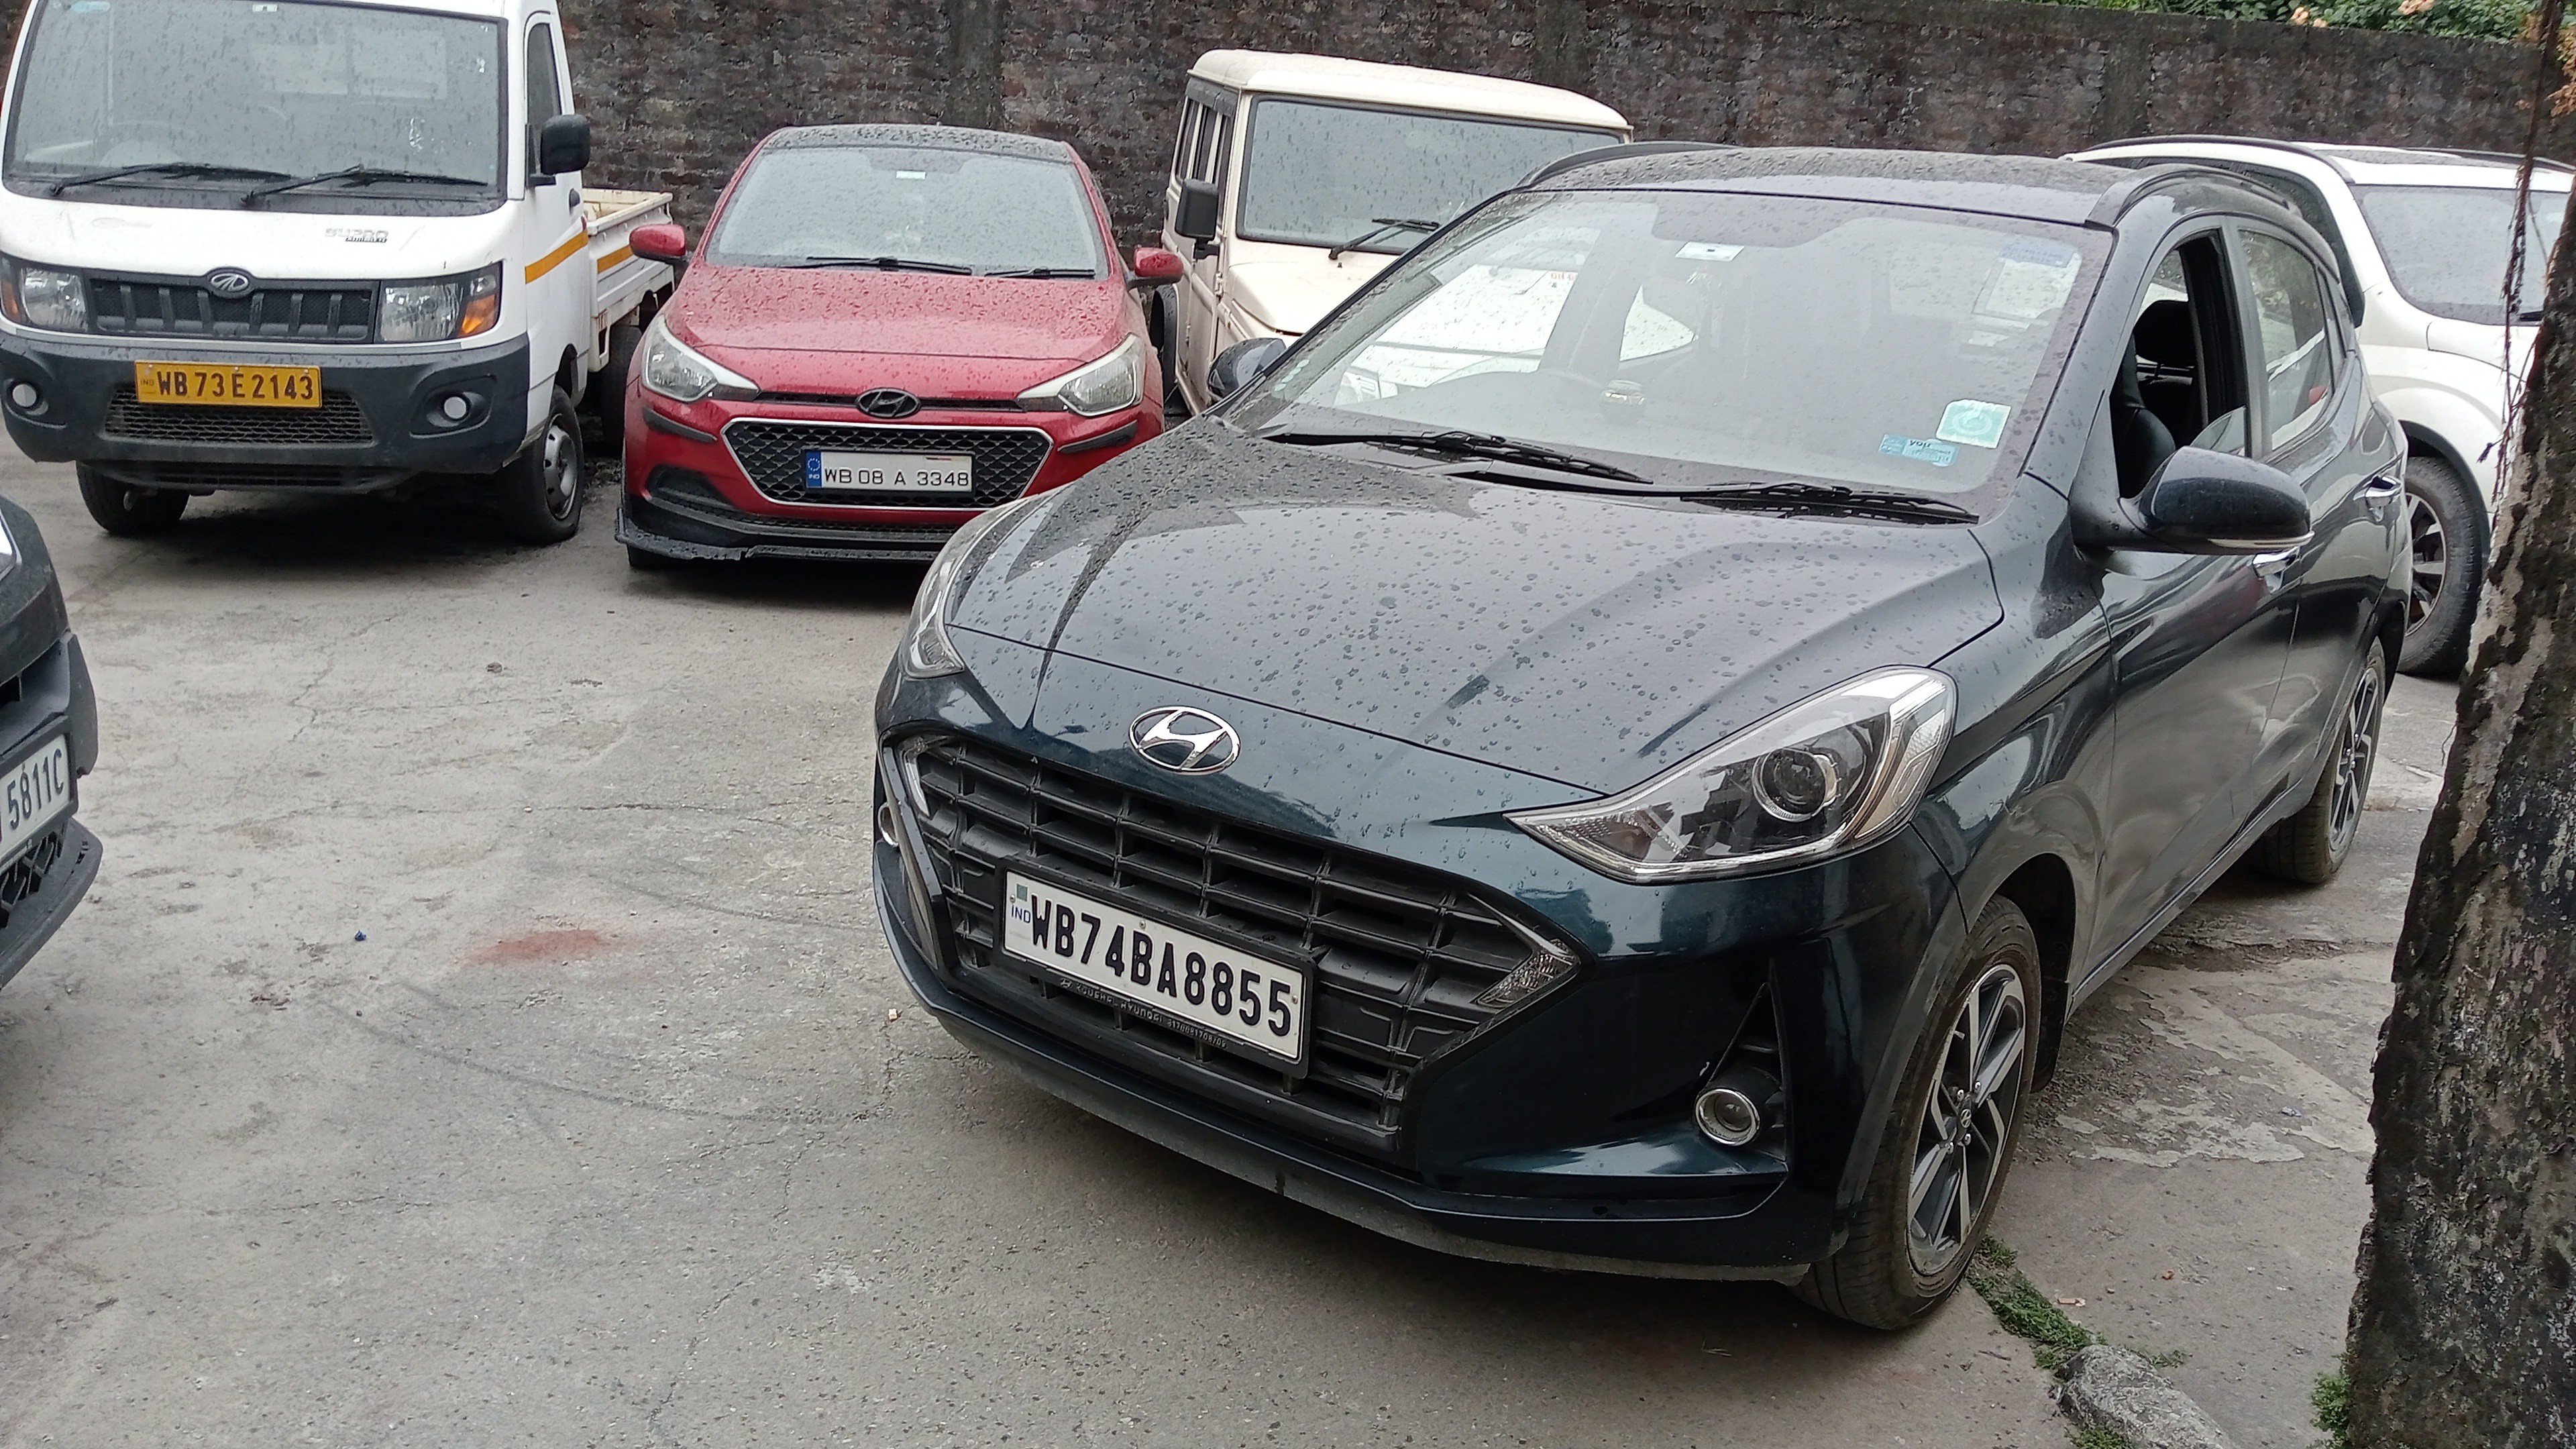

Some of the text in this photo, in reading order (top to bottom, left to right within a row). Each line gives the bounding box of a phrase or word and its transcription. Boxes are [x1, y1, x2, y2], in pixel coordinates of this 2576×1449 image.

[824, 468, 969, 486] WB 08 A 3348
[7, 748, 64, 830] 5811C
[1010, 905, 1031, 924] IND
[1031, 894, 1291, 1037] WB74BA8855
